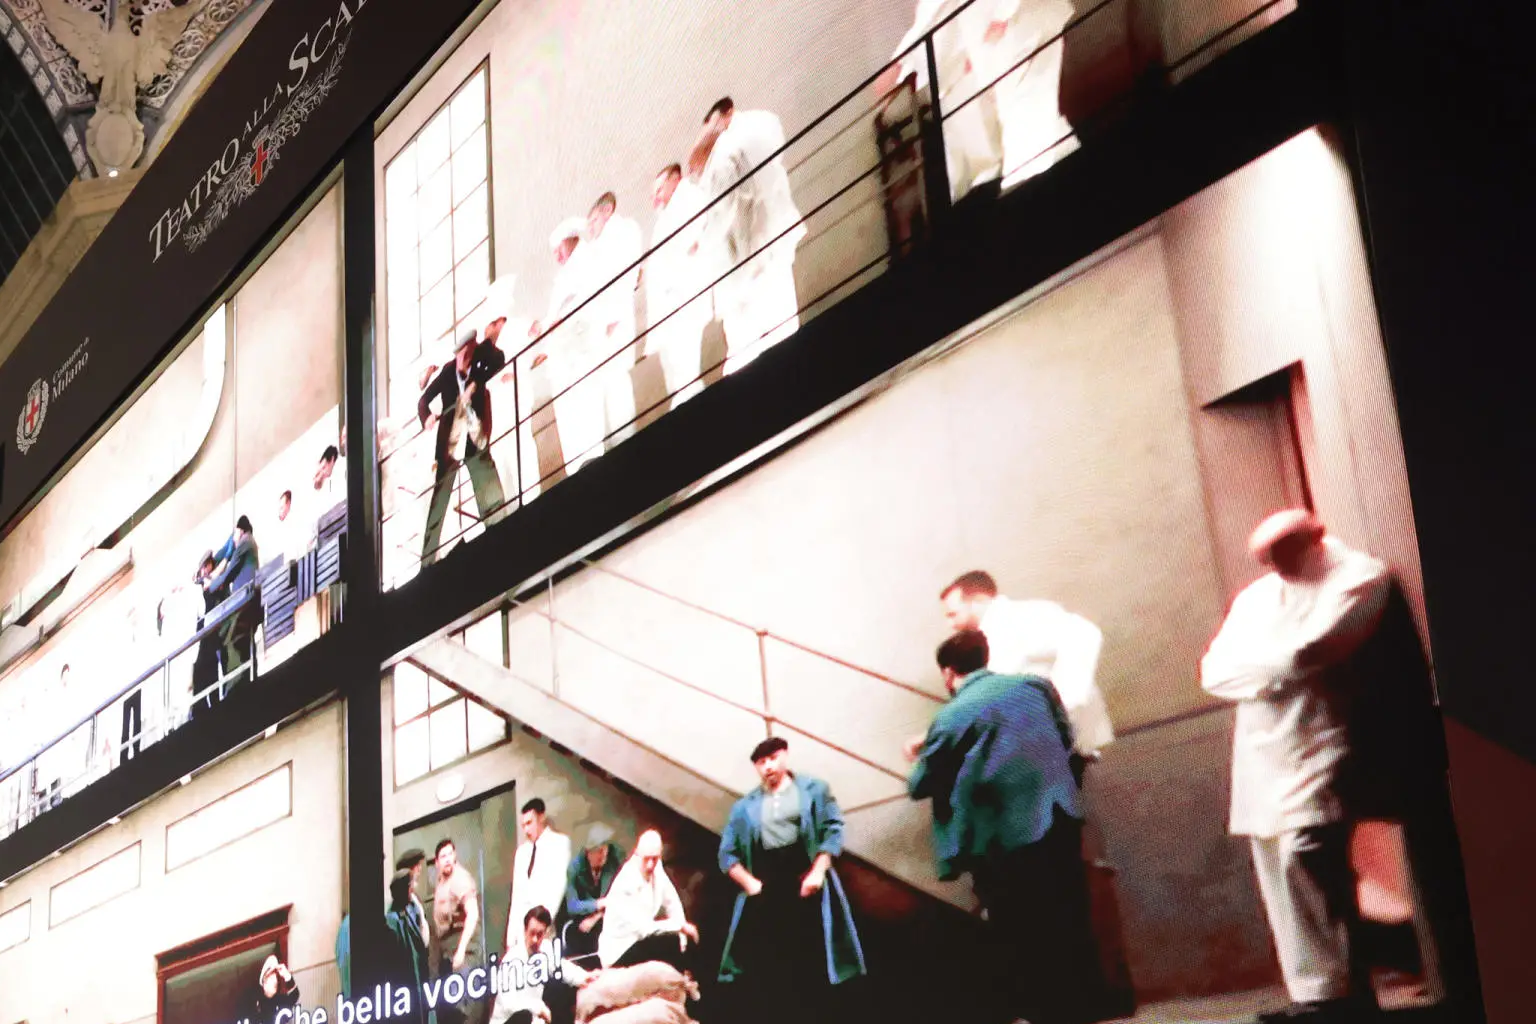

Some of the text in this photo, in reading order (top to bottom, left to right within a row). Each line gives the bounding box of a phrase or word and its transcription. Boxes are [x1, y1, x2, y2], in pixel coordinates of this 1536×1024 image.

[149, 0, 366, 263] TEATRO ALLA SCA
[52, 351, 89, 402] Milano
[53, 344, 83, 384] Comune
[423, 937, 563, 1009] vocina!
